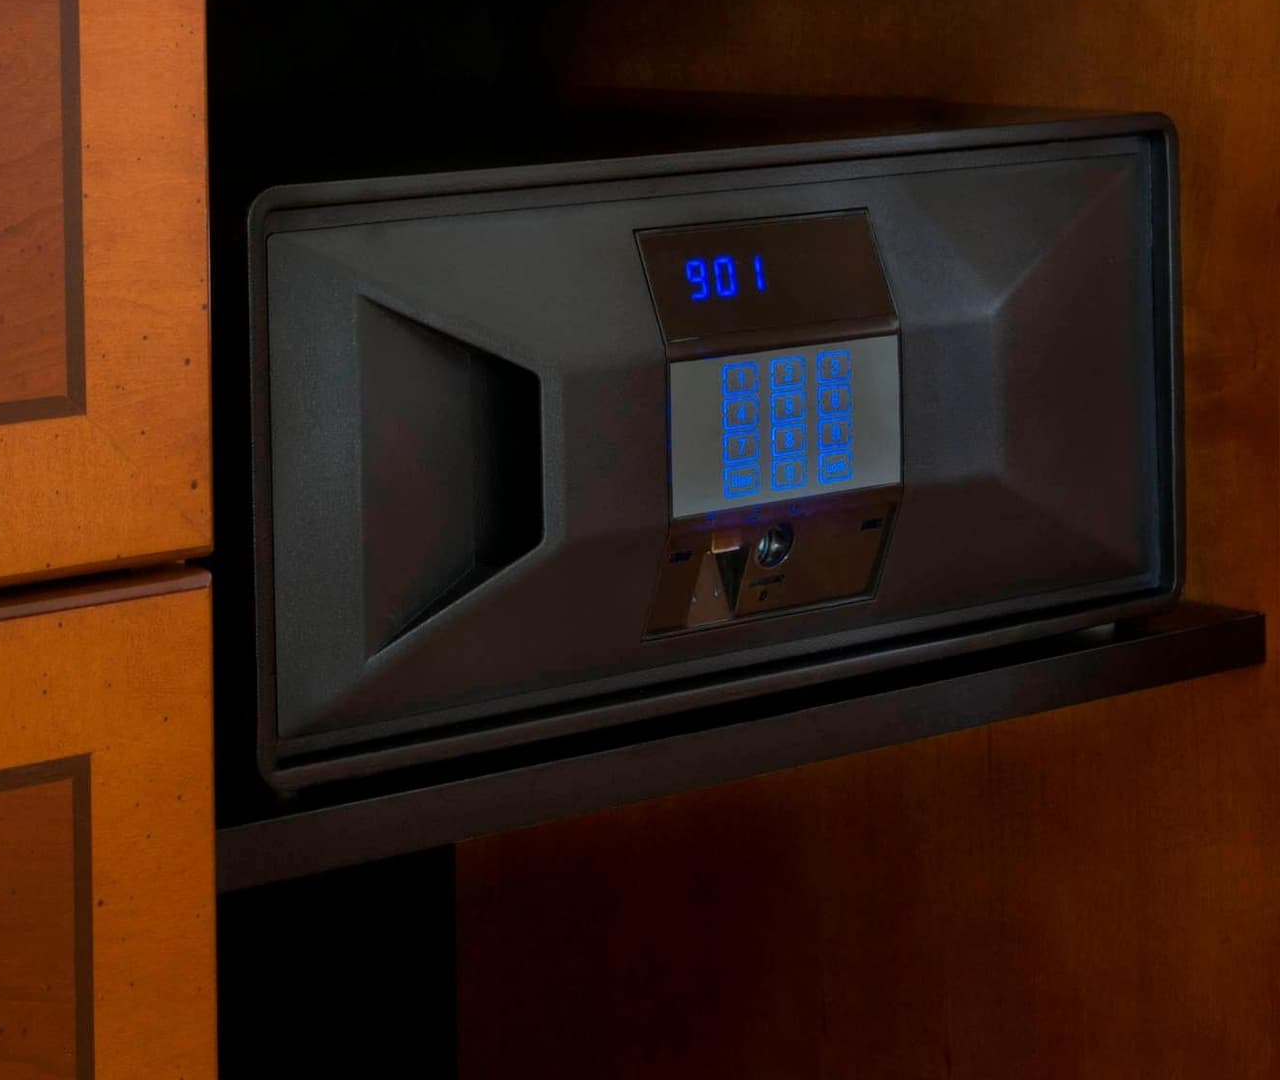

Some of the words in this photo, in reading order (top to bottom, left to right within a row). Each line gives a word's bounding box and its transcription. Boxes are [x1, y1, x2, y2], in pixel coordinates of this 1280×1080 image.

[685, 255, 768, 301] 901
[736, 370, 747, 388] 1
[783, 364, 795, 382] 2
[830, 358, 841, 376] 3
[736, 403, 748, 421] 4
[784, 397, 795, 415] 5
[736, 437, 748, 456] 7
[784, 431, 795, 449] 8
[831, 423, 842, 442] 9
[784, 464, 796, 482] 0
